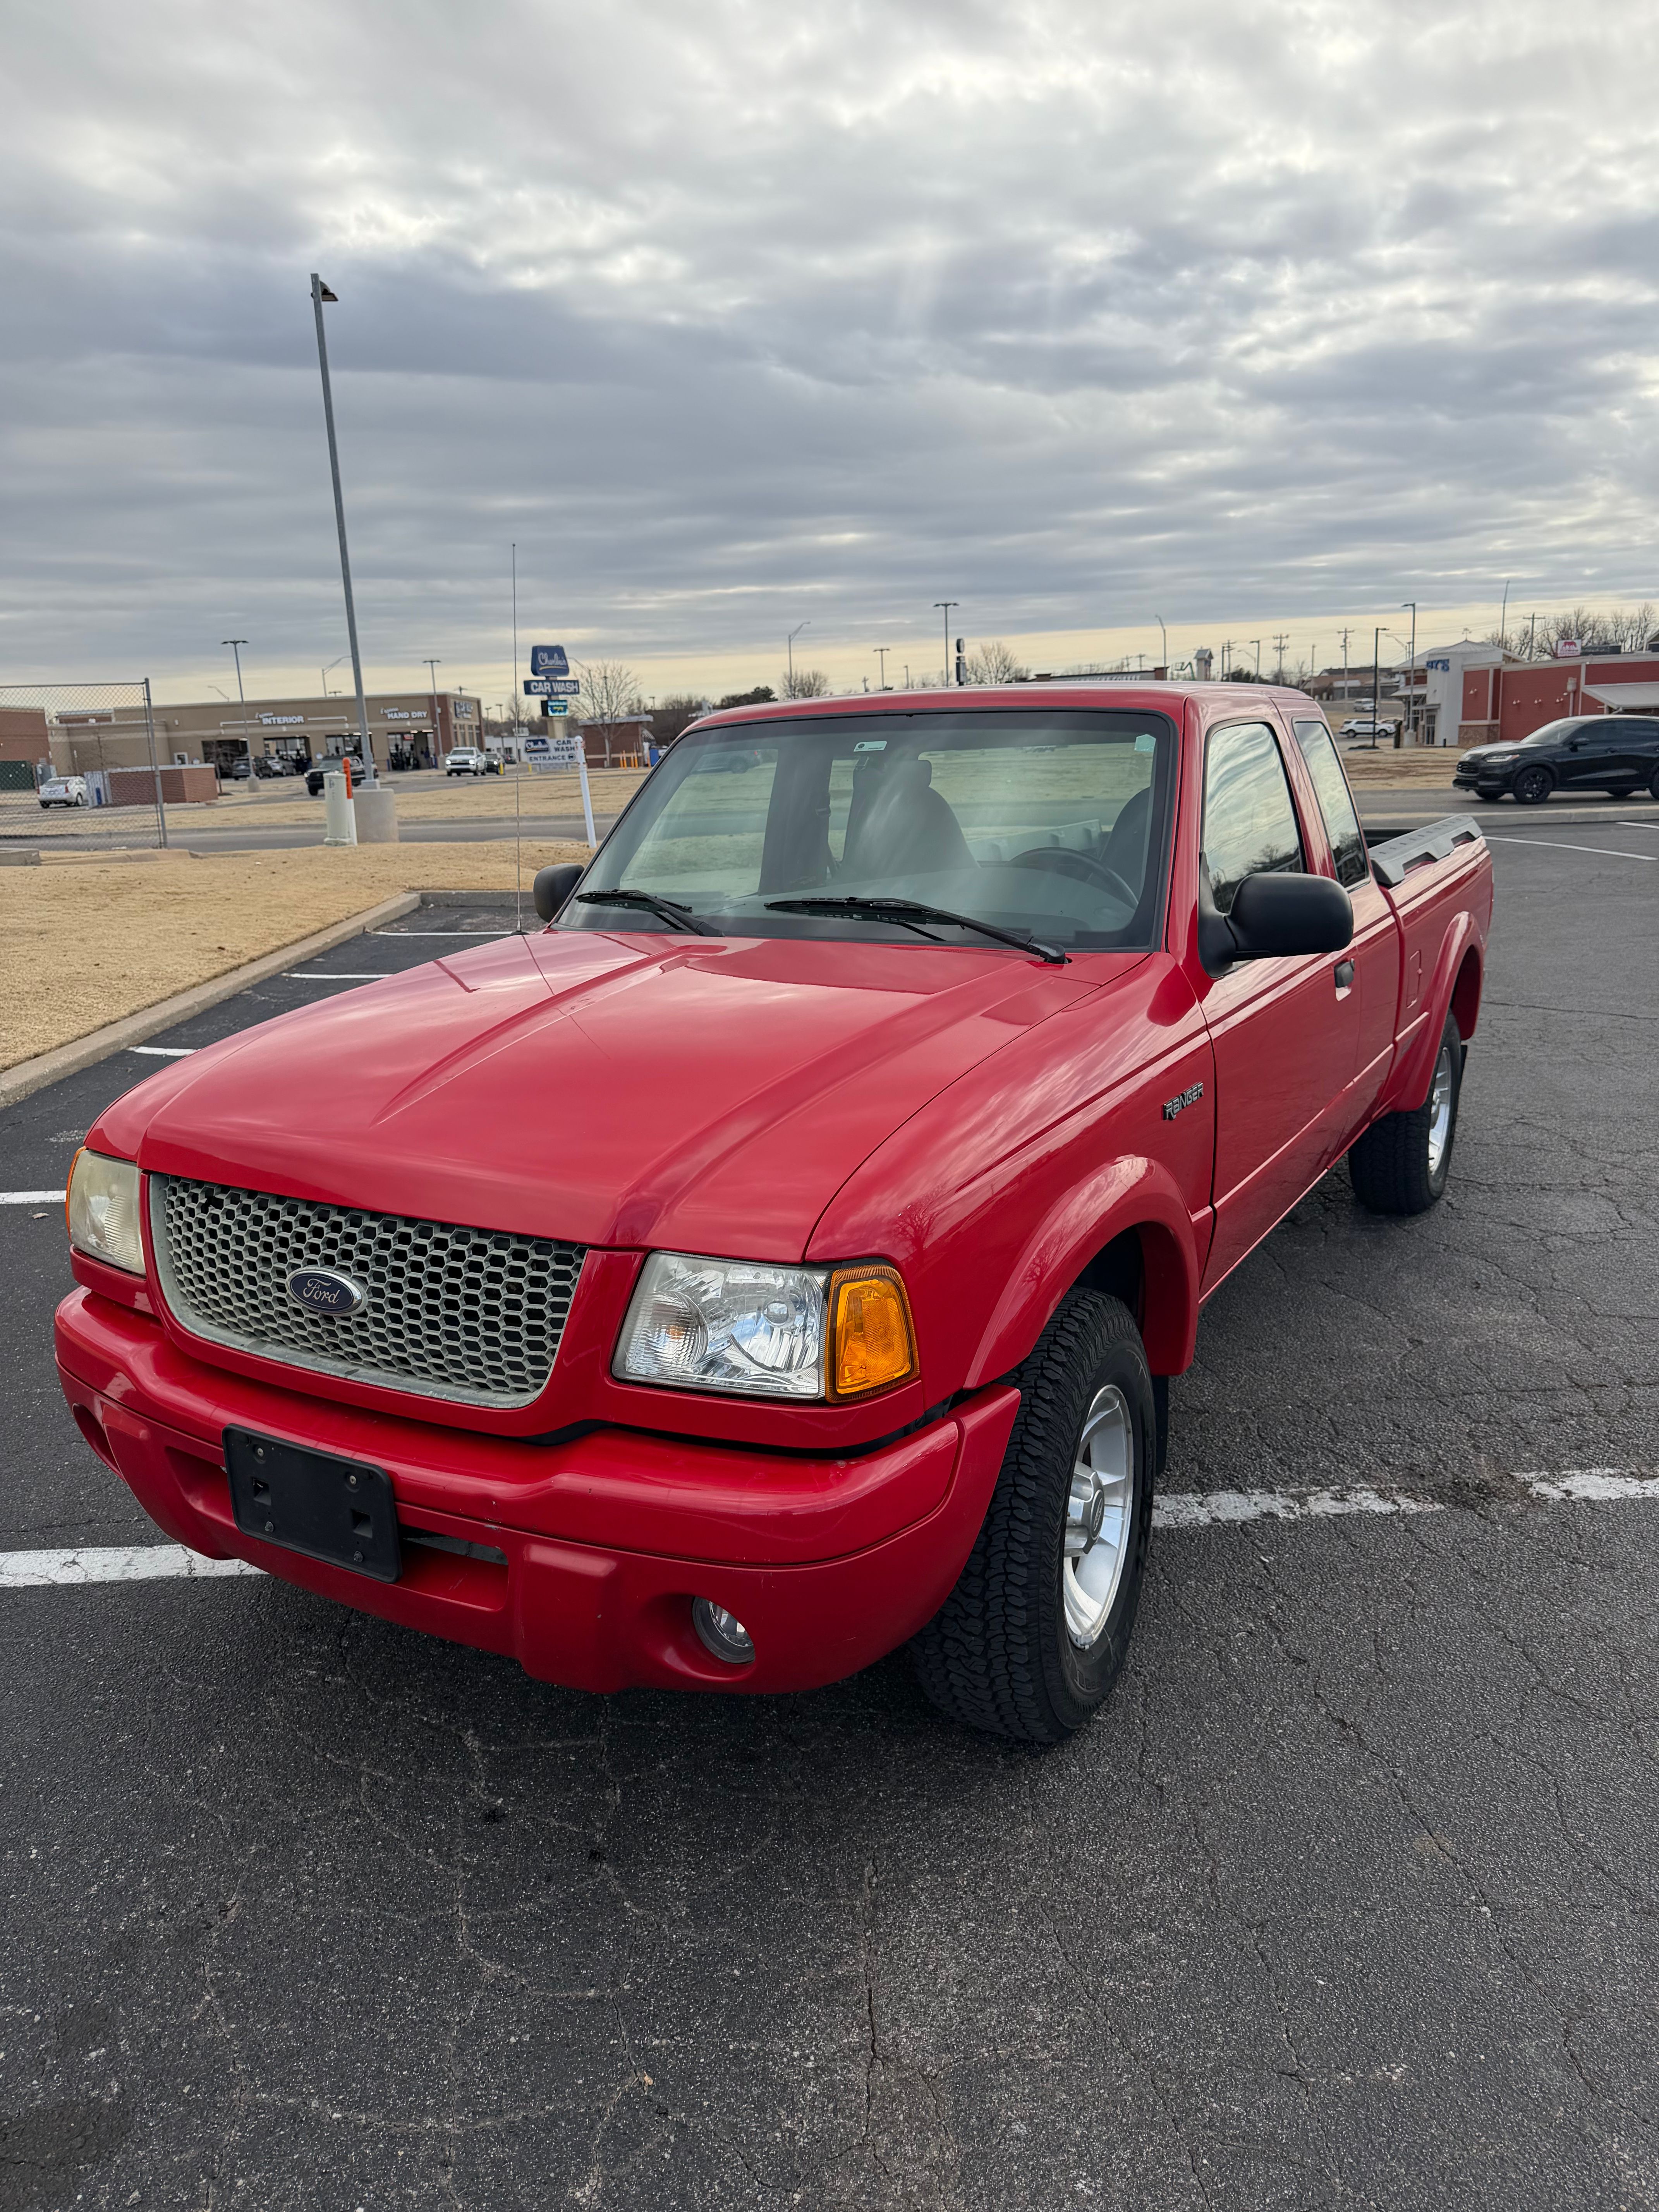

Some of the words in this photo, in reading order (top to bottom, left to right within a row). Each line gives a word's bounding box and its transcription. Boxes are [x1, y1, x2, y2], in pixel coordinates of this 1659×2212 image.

[531, 682, 551, 693] CAR
[552, 681, 578, 693] WASH
[262, 715, 304, 725] INTERIOR
[1163, 1082, 1204, 1120] RANGER
[303, 1278, 340, 1304] Ford
